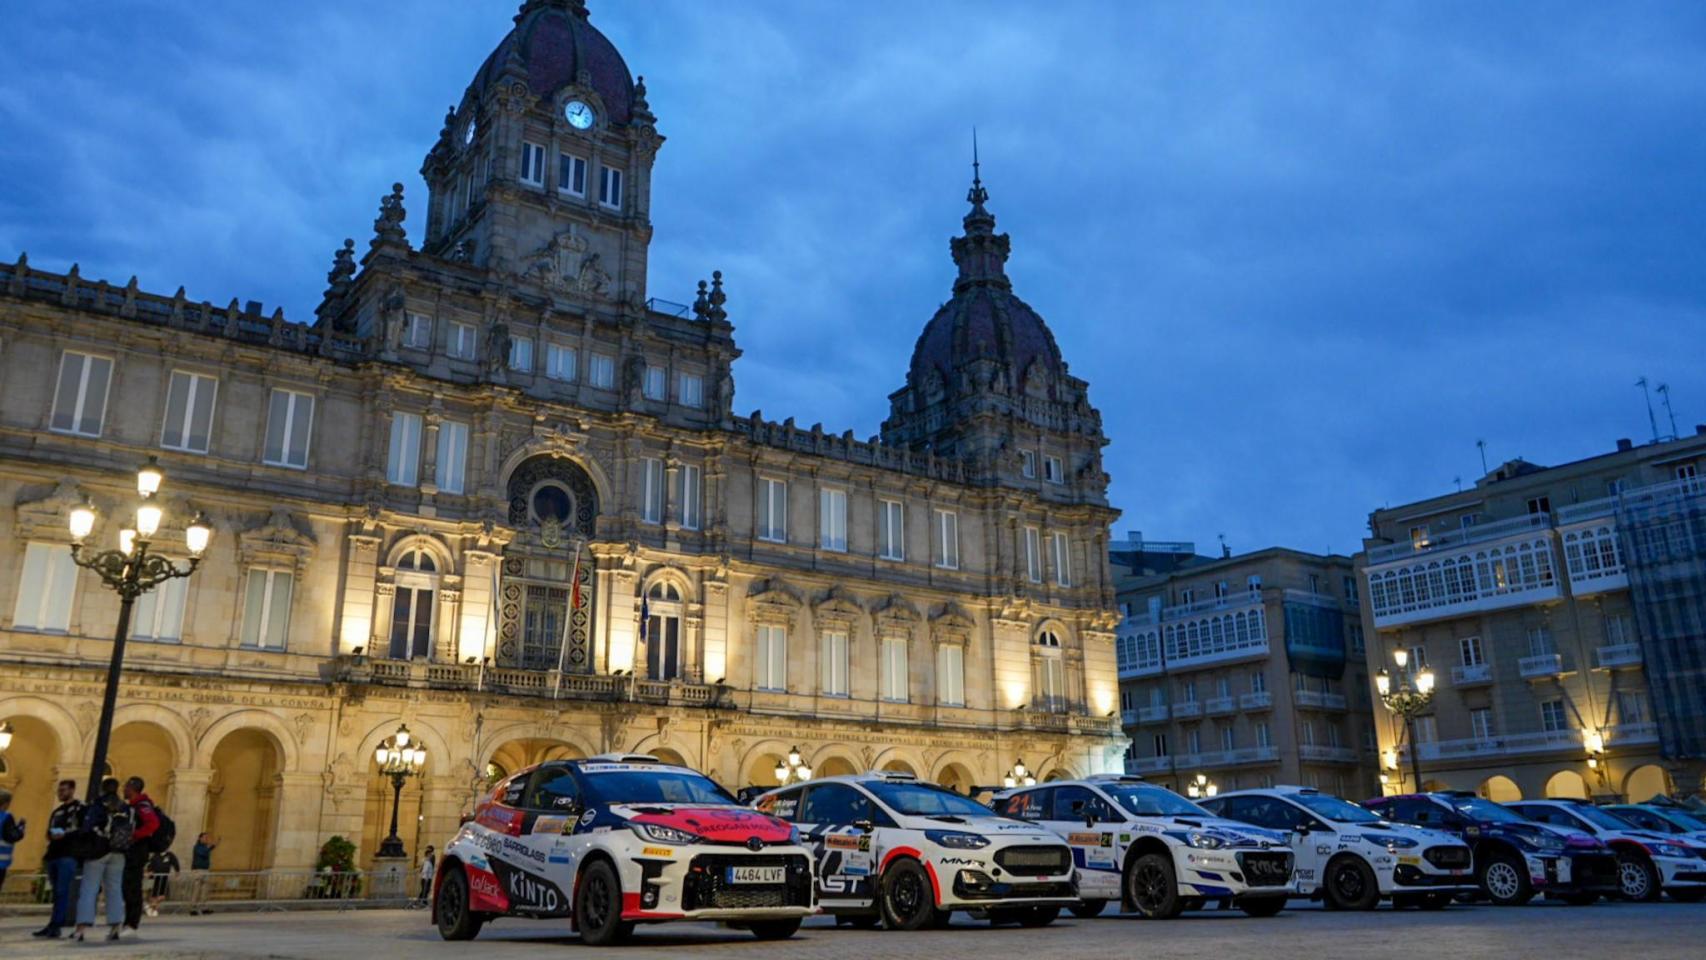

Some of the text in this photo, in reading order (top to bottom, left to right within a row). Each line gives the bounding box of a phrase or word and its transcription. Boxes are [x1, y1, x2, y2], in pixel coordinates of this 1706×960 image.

[1007, 794, 1029, 814] 21
[643, 847, 672, 857] PIRELLI
[734, 868, 783, 882] 4464 LVF
